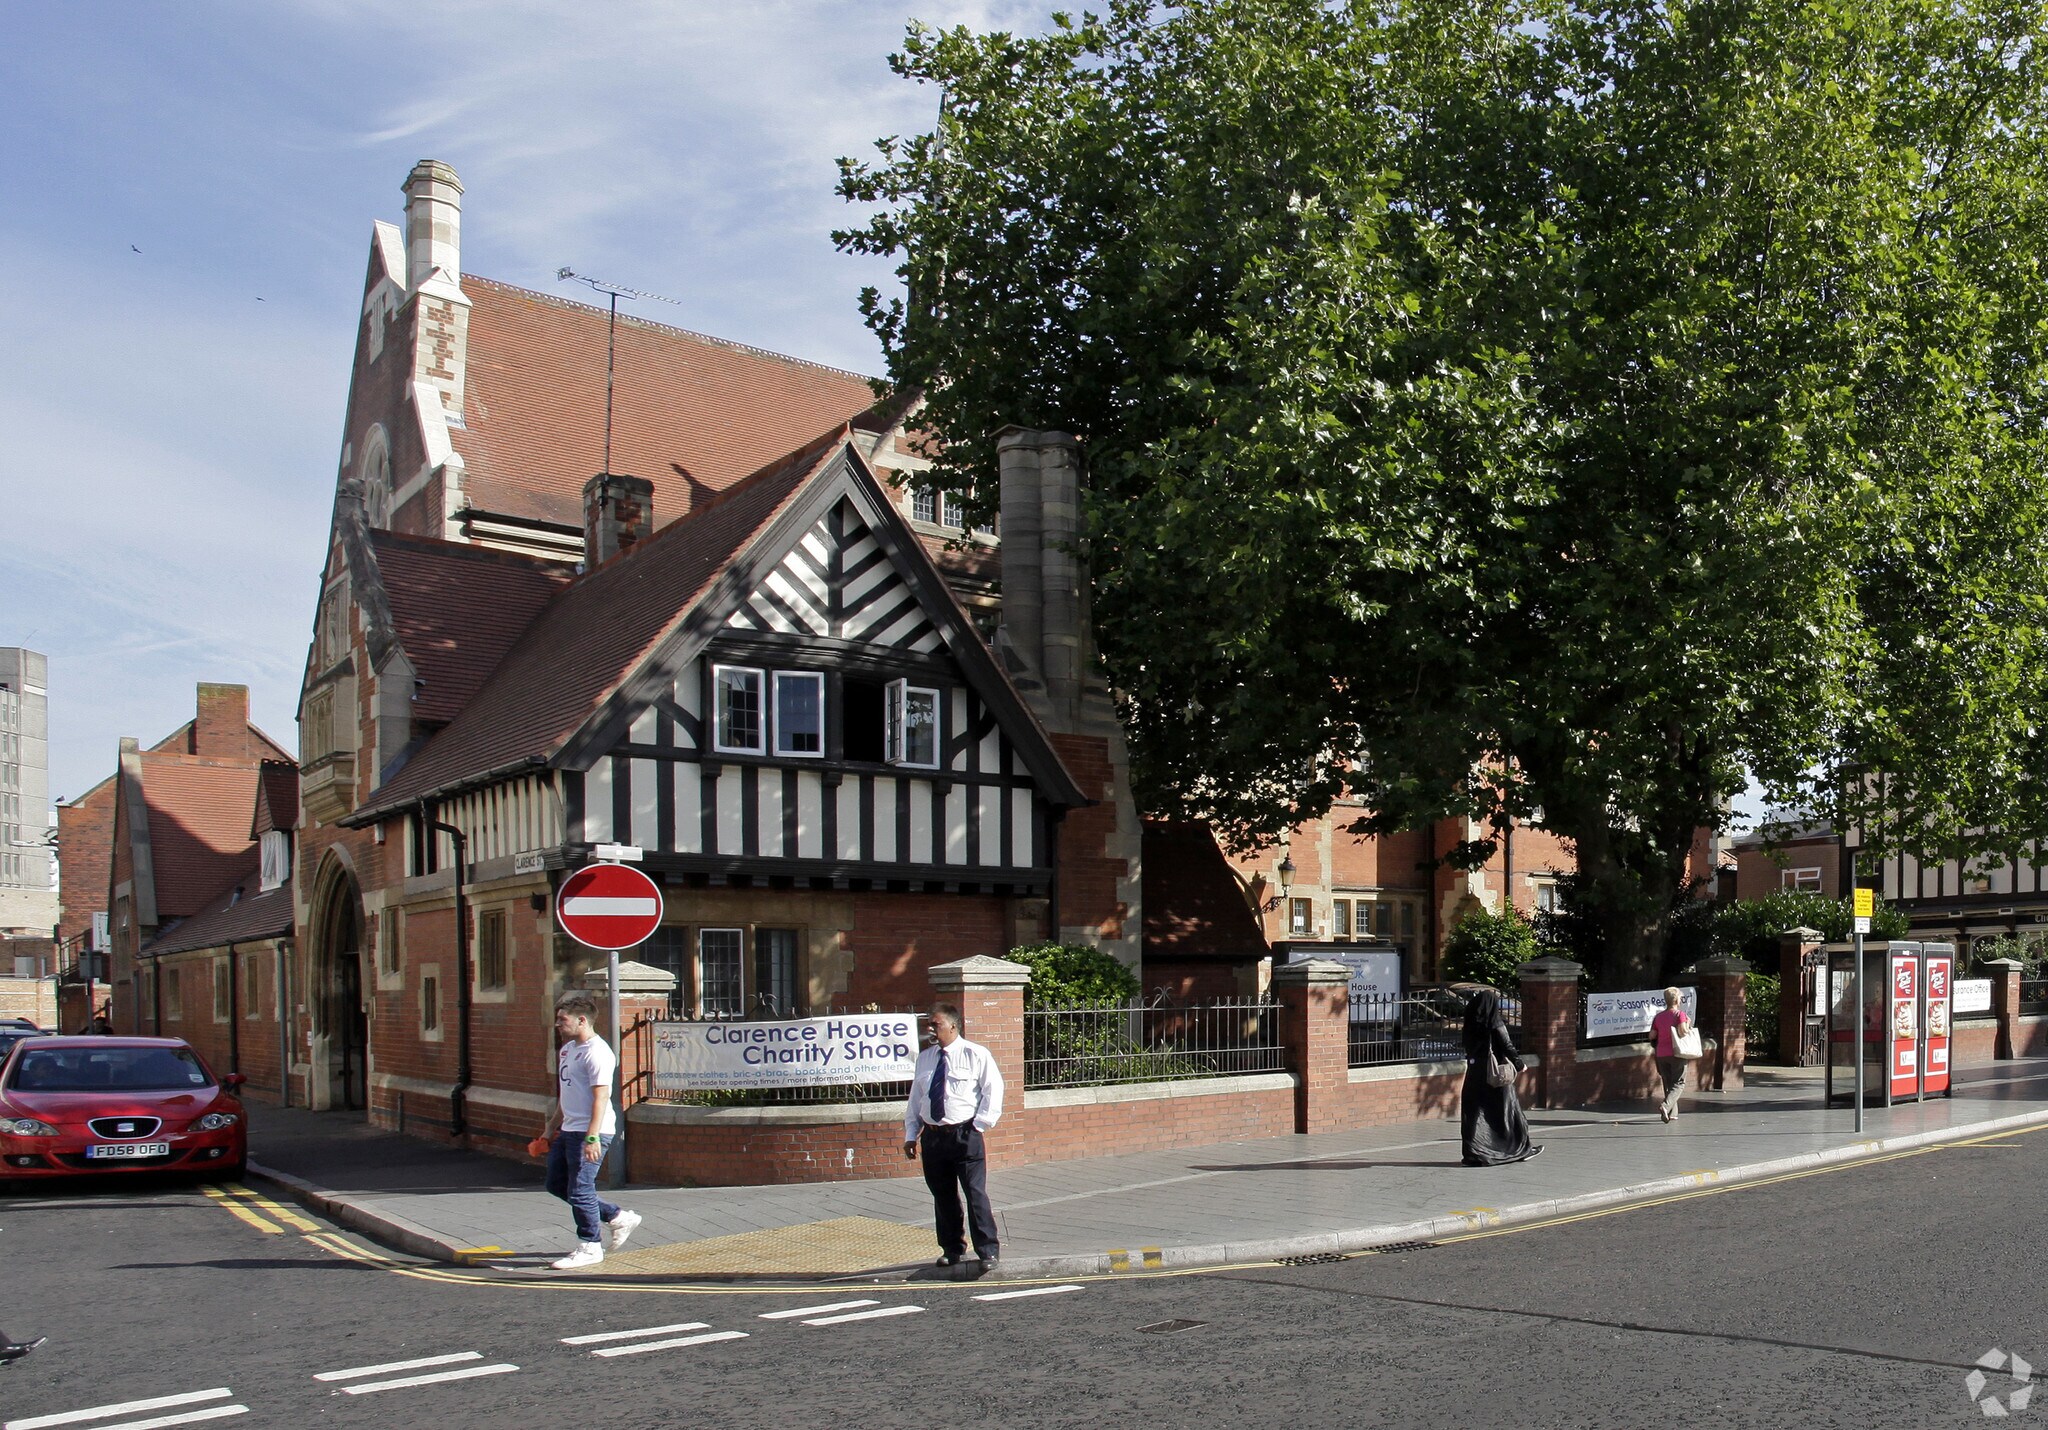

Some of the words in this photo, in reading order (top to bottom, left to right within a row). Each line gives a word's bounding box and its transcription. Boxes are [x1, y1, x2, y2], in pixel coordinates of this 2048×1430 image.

[1351, 983, 1377, 991] House
[1953, 986, 1973, 994] surance
[1616, 999, 1650, 1010] Seasons
[1593, 1017, 1605, 1025] Call
[705, 1025, 817, 1044] Clarence
[827, 1021, 908, 1040] House
[743, 1043, 834, 1065] Charity
[843, 1041, 909, 1061] Shop
[699, 1070, 731, 1079] clothes,
[733, 1068, 792, 1078] bric-a-brac,
[795, 1066, 826, 1076] books
[830, 1065, 850, 1075] and
[854, 1064, 880, 1074] other
[884, 1063, 911, 1071] items
[700, 1079, 717, 1087] inside
[730, 1079, 758, 1087] opening
[810, 1074, 858, 1083] information)
[96, 1145, 135, 1156] FD58
